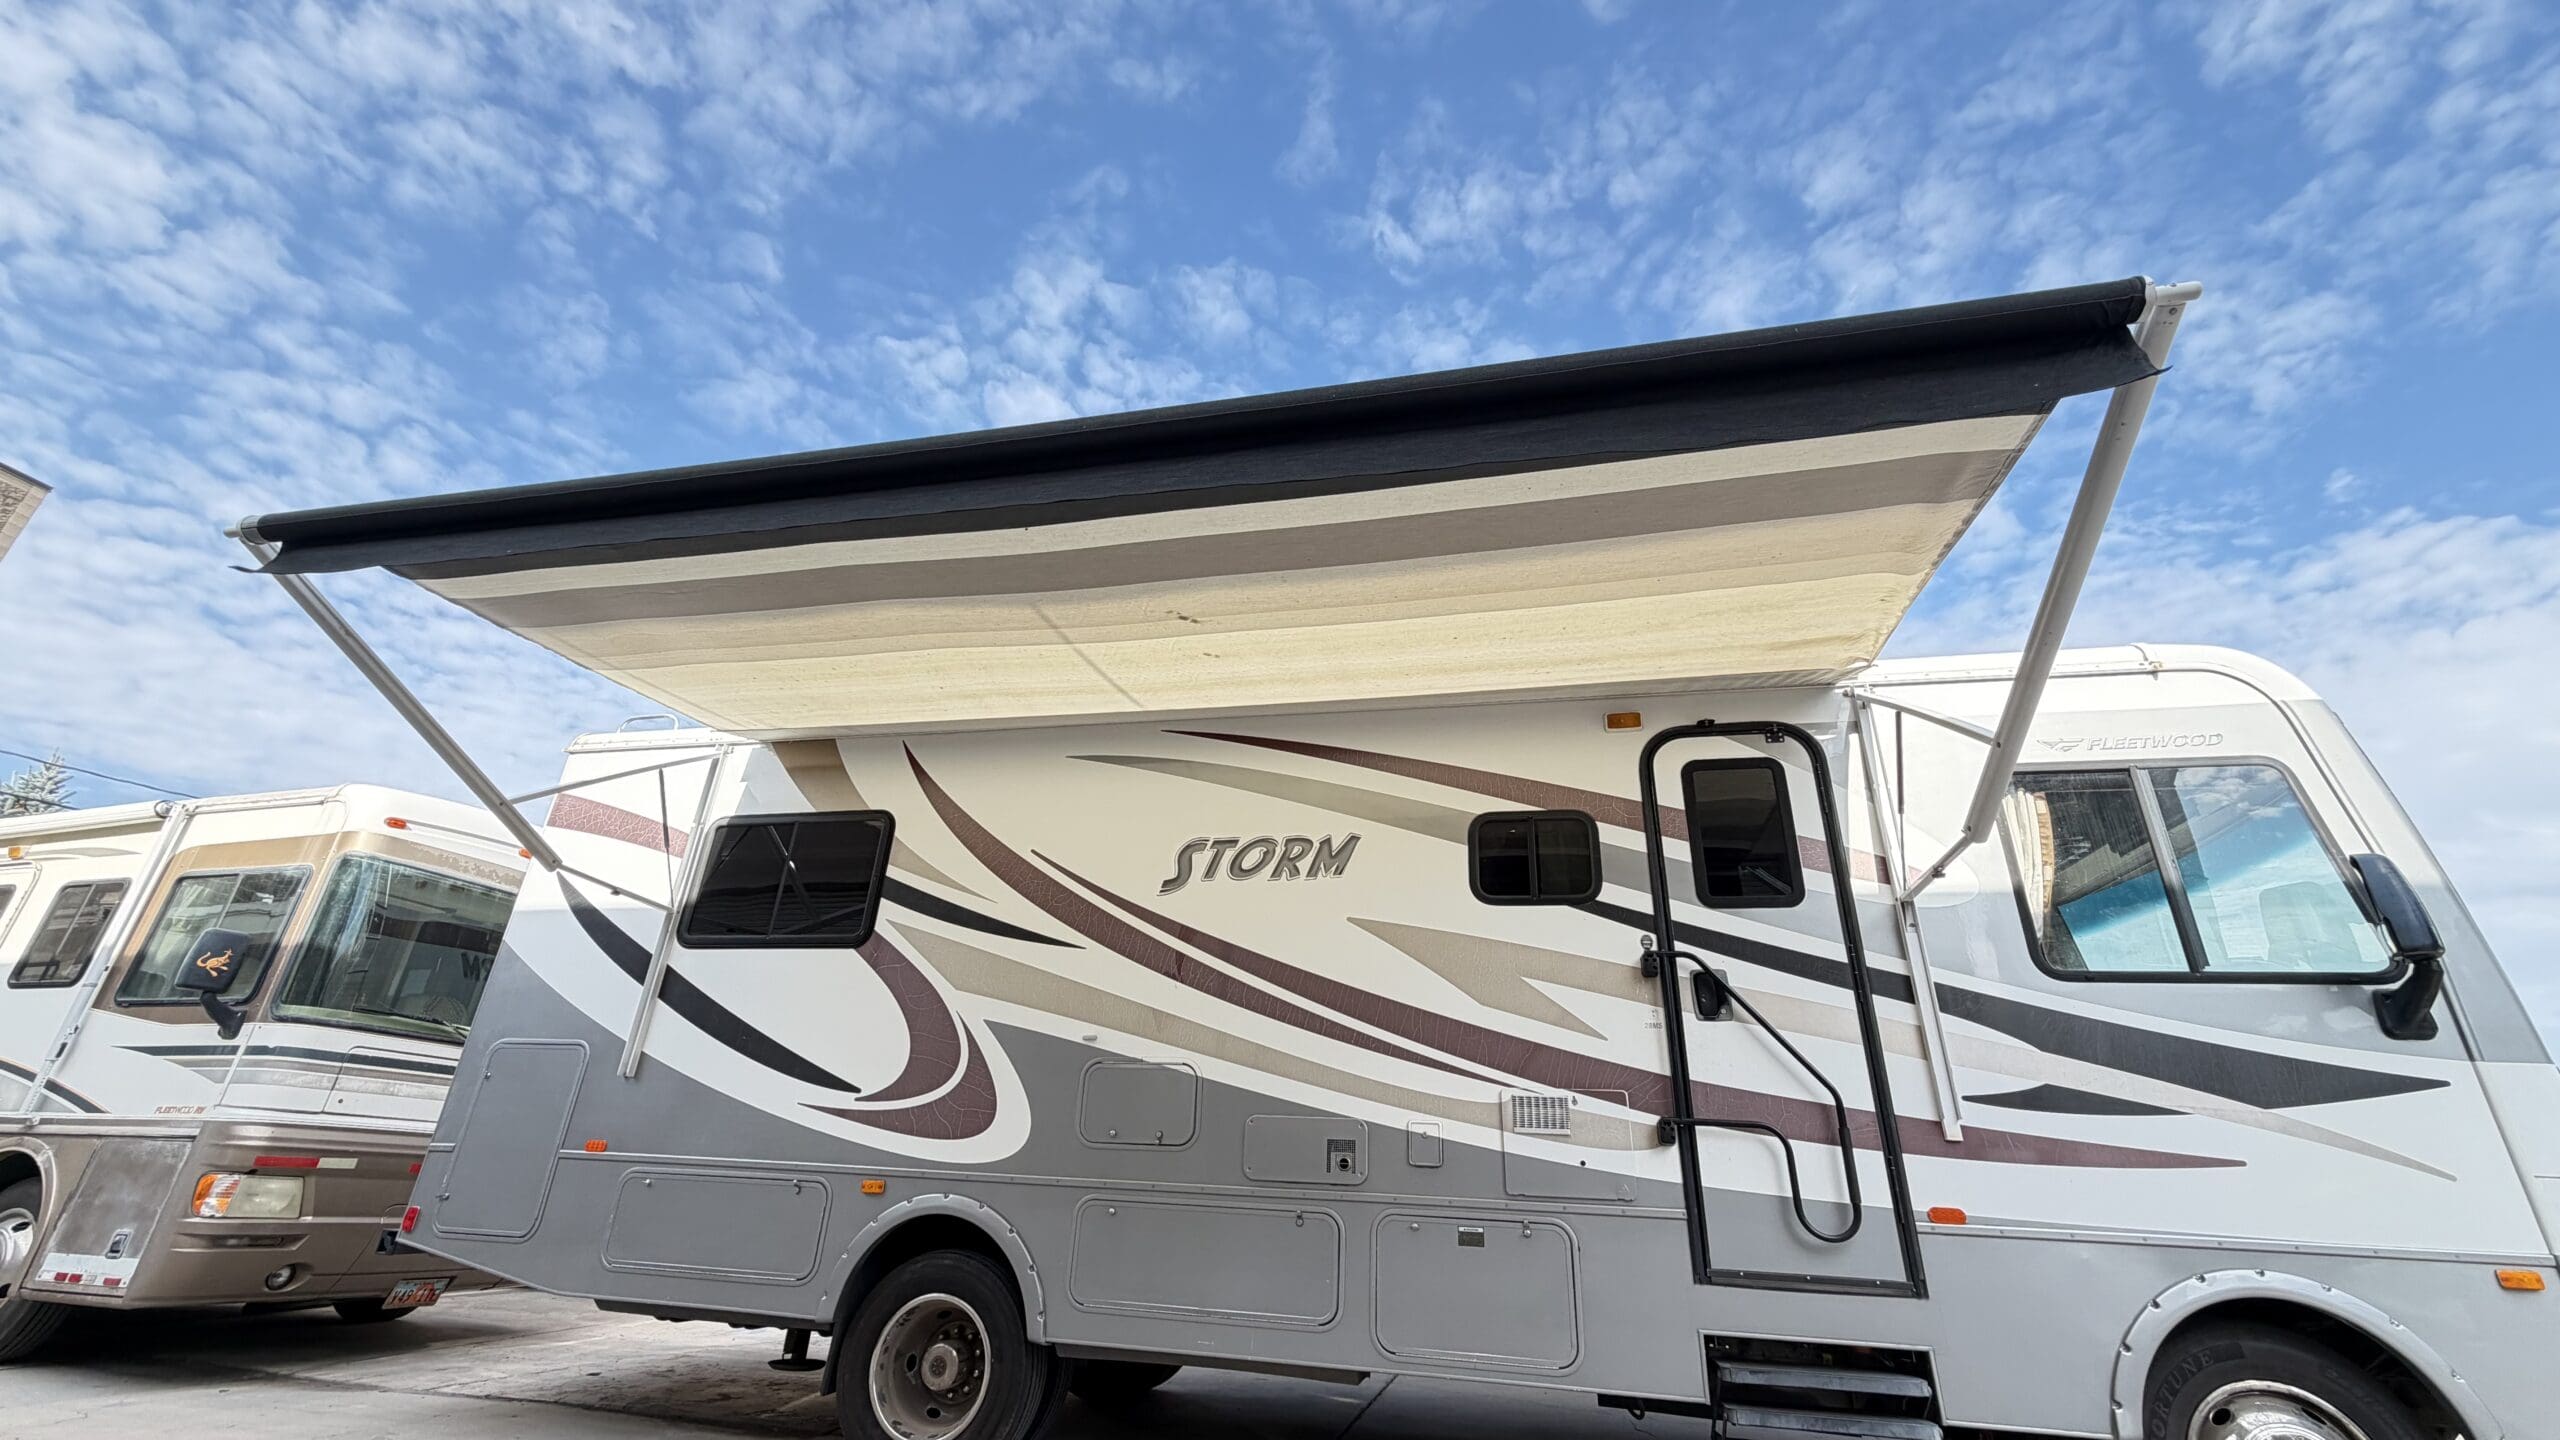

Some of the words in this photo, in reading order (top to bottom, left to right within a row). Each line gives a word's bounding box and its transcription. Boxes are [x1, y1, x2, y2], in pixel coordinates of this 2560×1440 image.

[2087, 733, 2224, 751] FLEETWOOD
[1157, 832, 1362, 897] STORM
[2150, 1349, 2214, 1440] ORTUNE
